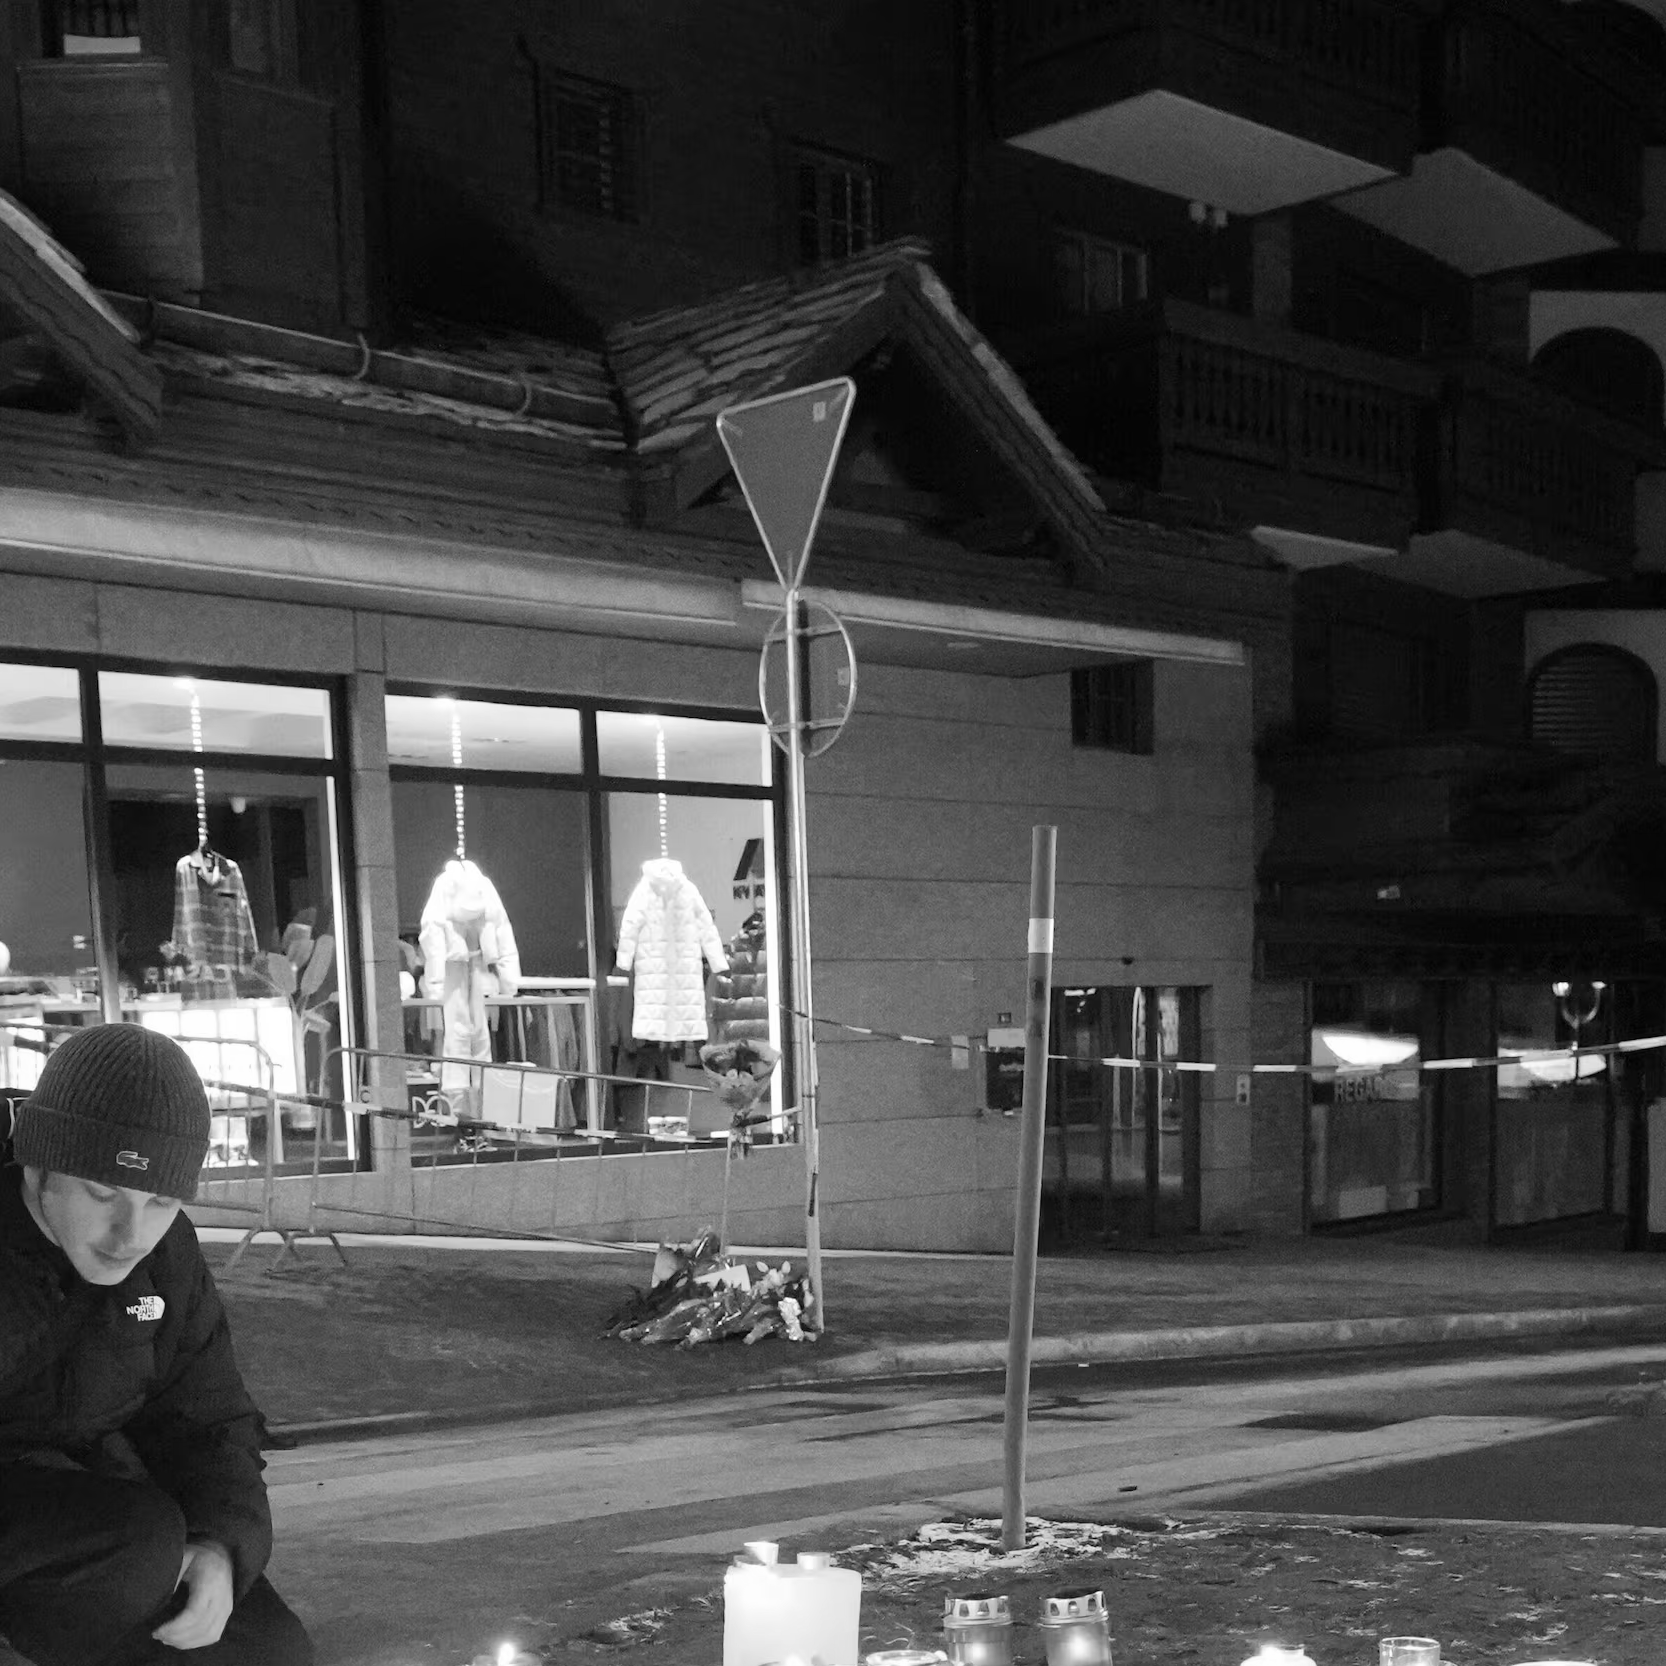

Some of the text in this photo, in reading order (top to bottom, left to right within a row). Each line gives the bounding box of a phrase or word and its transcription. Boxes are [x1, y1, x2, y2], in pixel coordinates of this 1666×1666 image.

[138, 1296, 154, 1305] THE
[126, 1305, 154, 1315] NORTH
[137, 1313, 154, 1321] FACE
